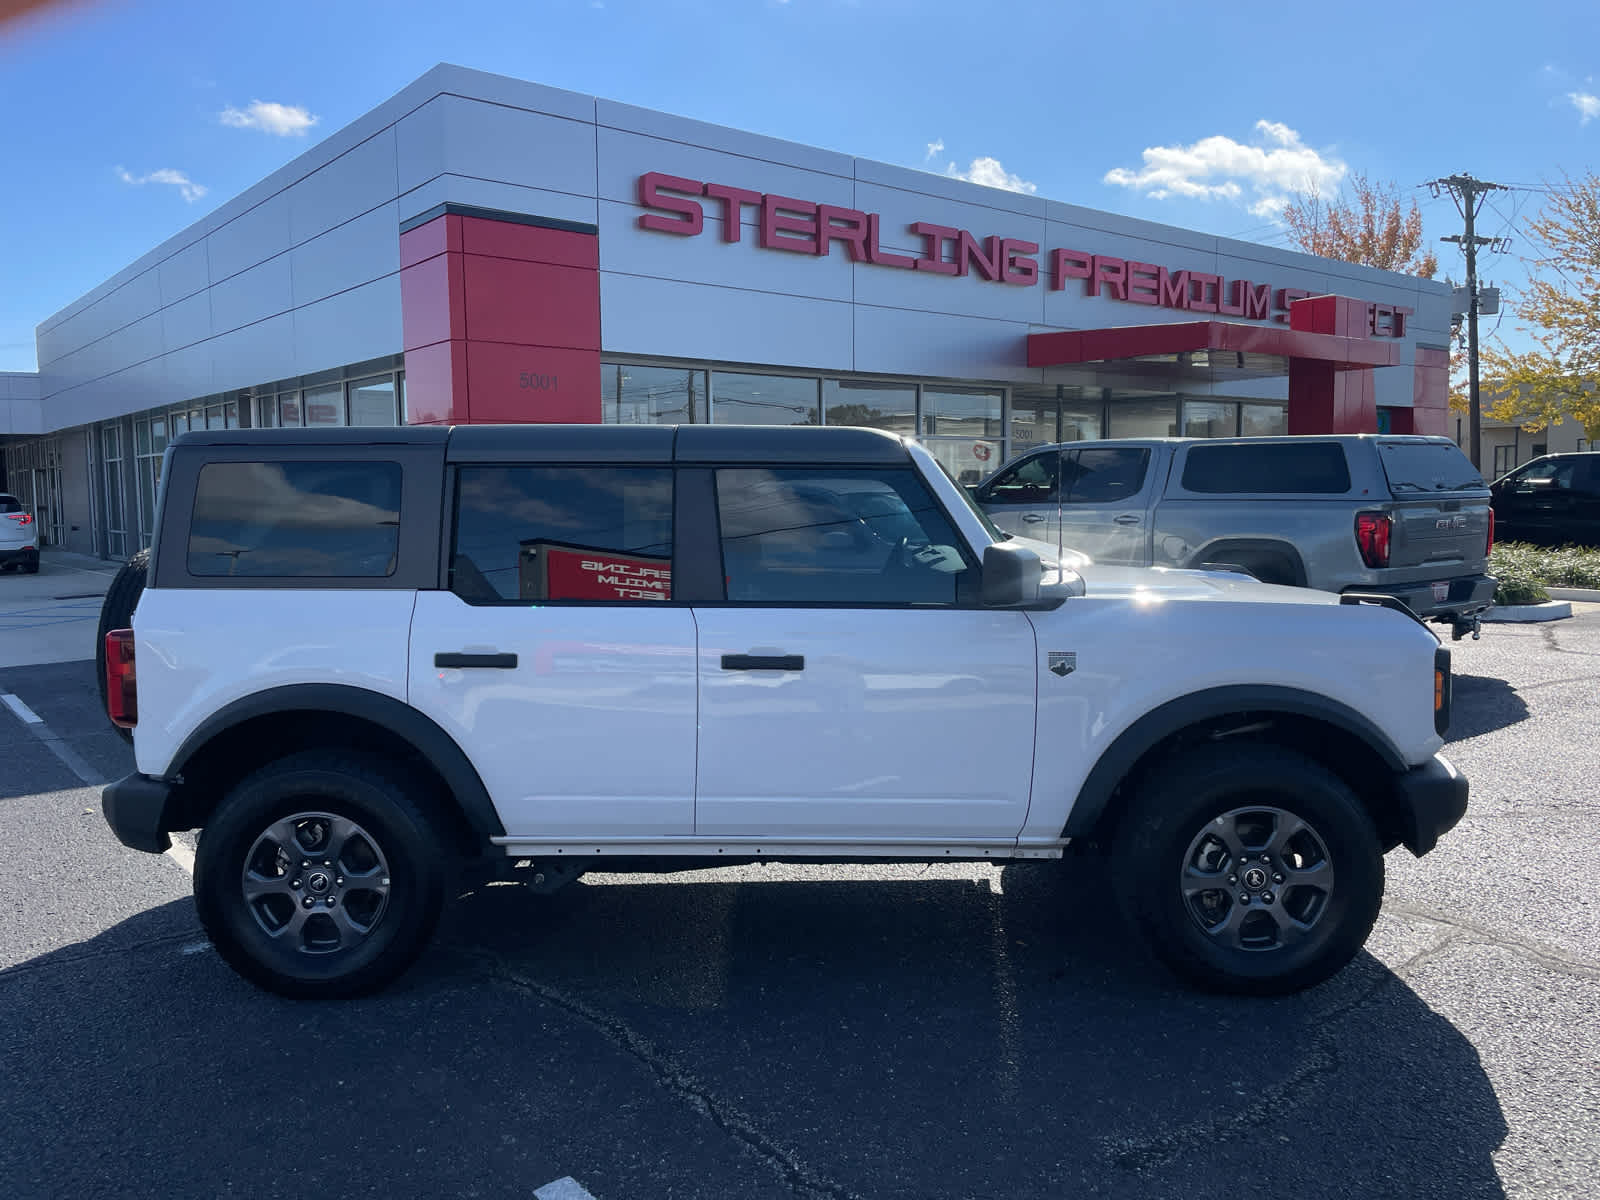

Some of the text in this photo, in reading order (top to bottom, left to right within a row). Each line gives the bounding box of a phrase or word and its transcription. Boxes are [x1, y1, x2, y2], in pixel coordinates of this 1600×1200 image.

[639, 171, 1039, 287] STERLING
[1051, 247, 1271, 321] PREMIUM
[519, 371, 558, 392] 5001
